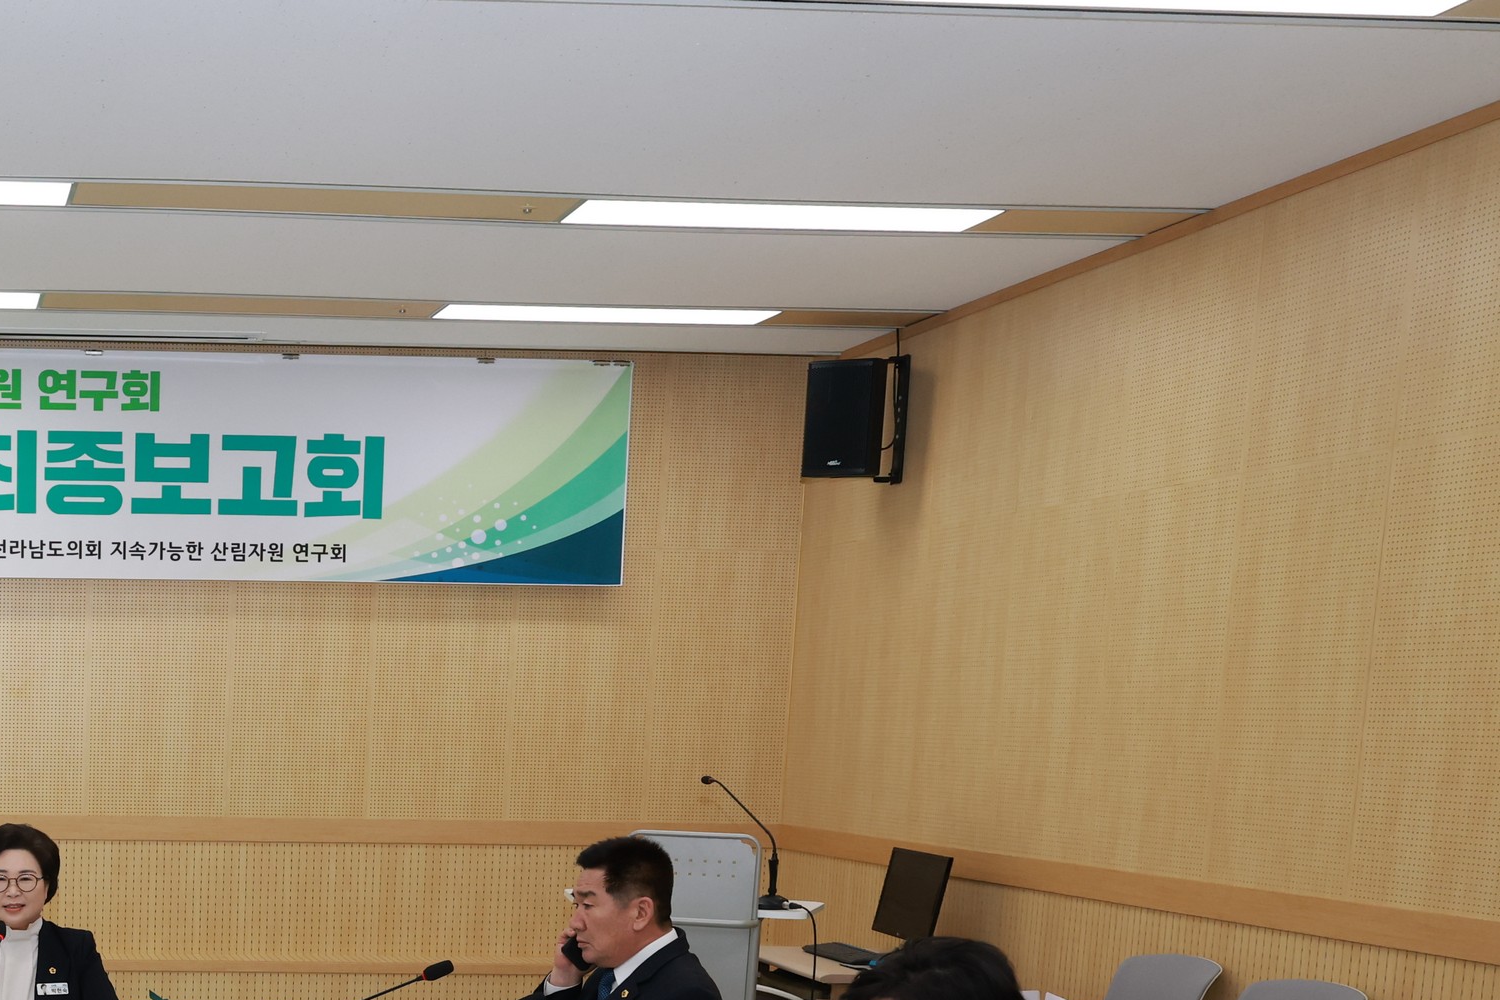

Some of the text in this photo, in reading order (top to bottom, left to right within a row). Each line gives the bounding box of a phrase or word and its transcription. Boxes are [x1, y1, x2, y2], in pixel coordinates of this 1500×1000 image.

[37, 368, 161, 413] 연구회
[110, 540, 205, 563] 지속가능한
[210, 542, 286, 564] 산림자원
[291, 543, 349, 565] 연구회
